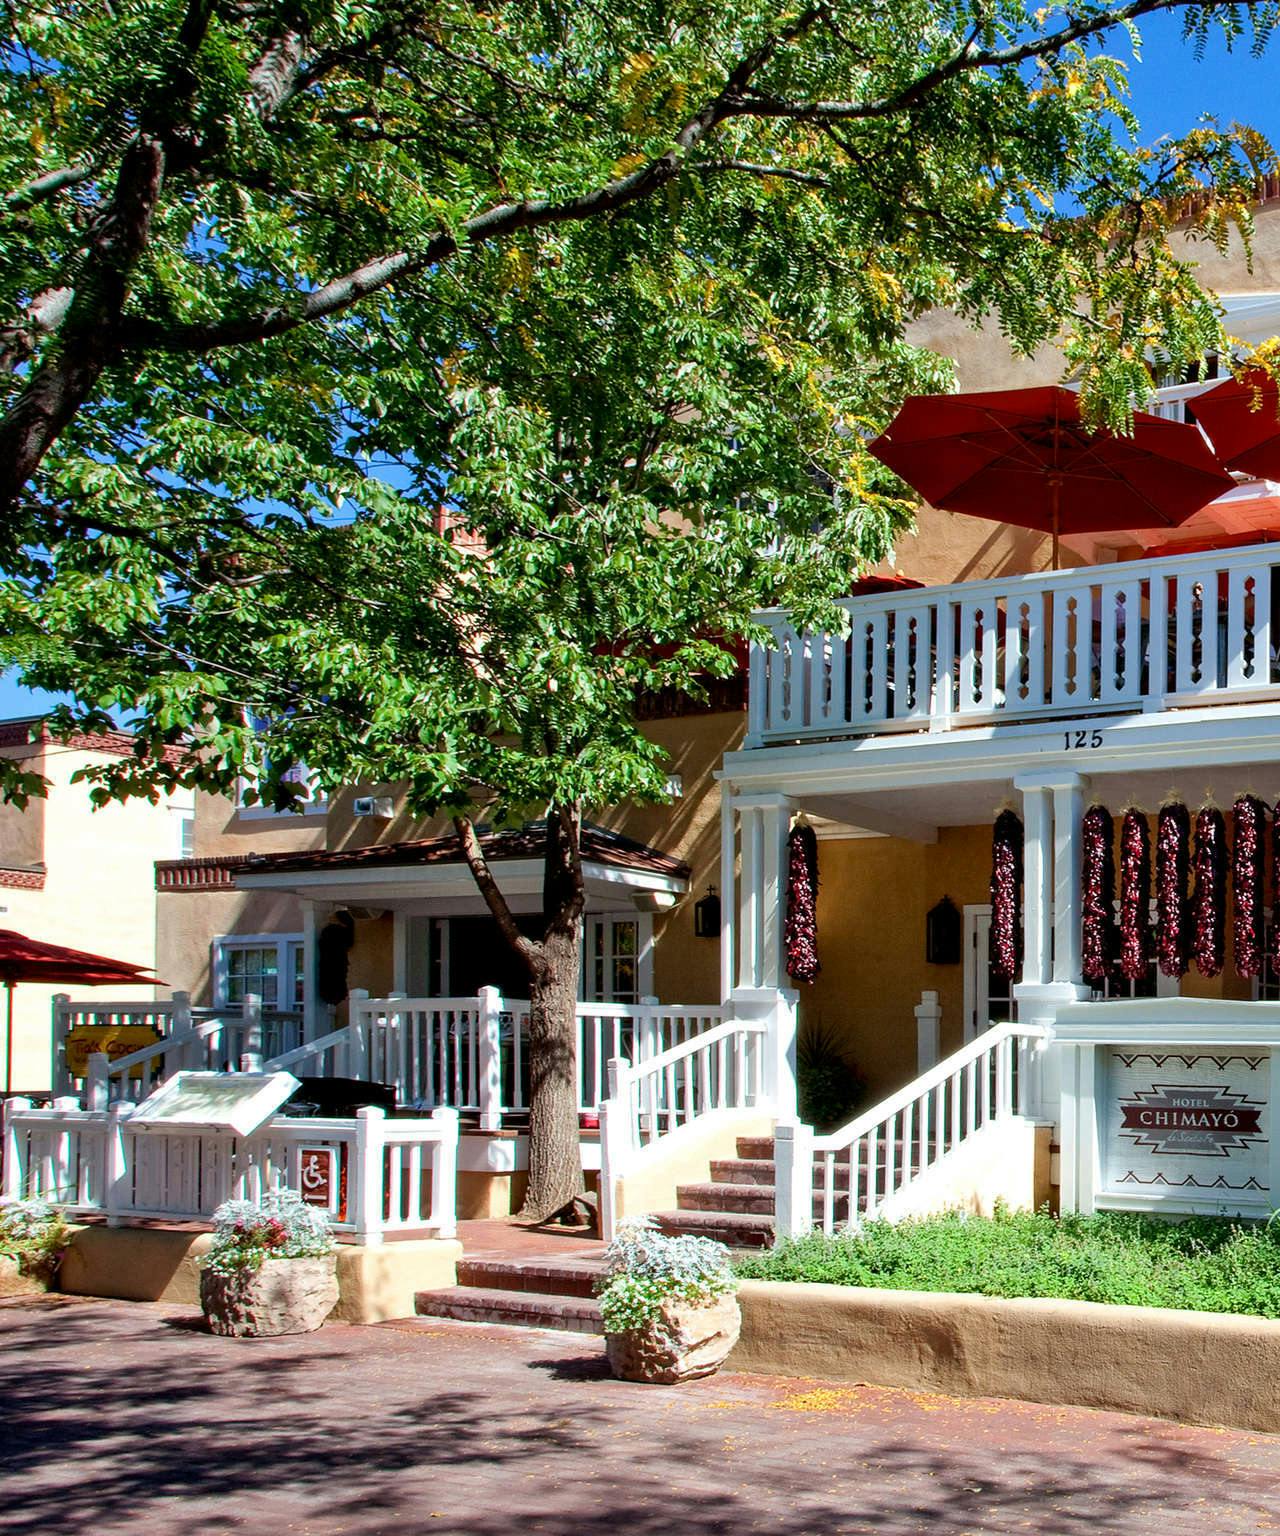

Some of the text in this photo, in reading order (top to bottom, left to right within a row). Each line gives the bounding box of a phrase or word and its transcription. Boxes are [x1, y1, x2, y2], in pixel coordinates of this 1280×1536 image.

[1064, 729, 1103, 750] 125
[1172, 1098, 1209, 1107] HOTEL
[1140, 1110, 1239, 1128] CHIMAYÓ
